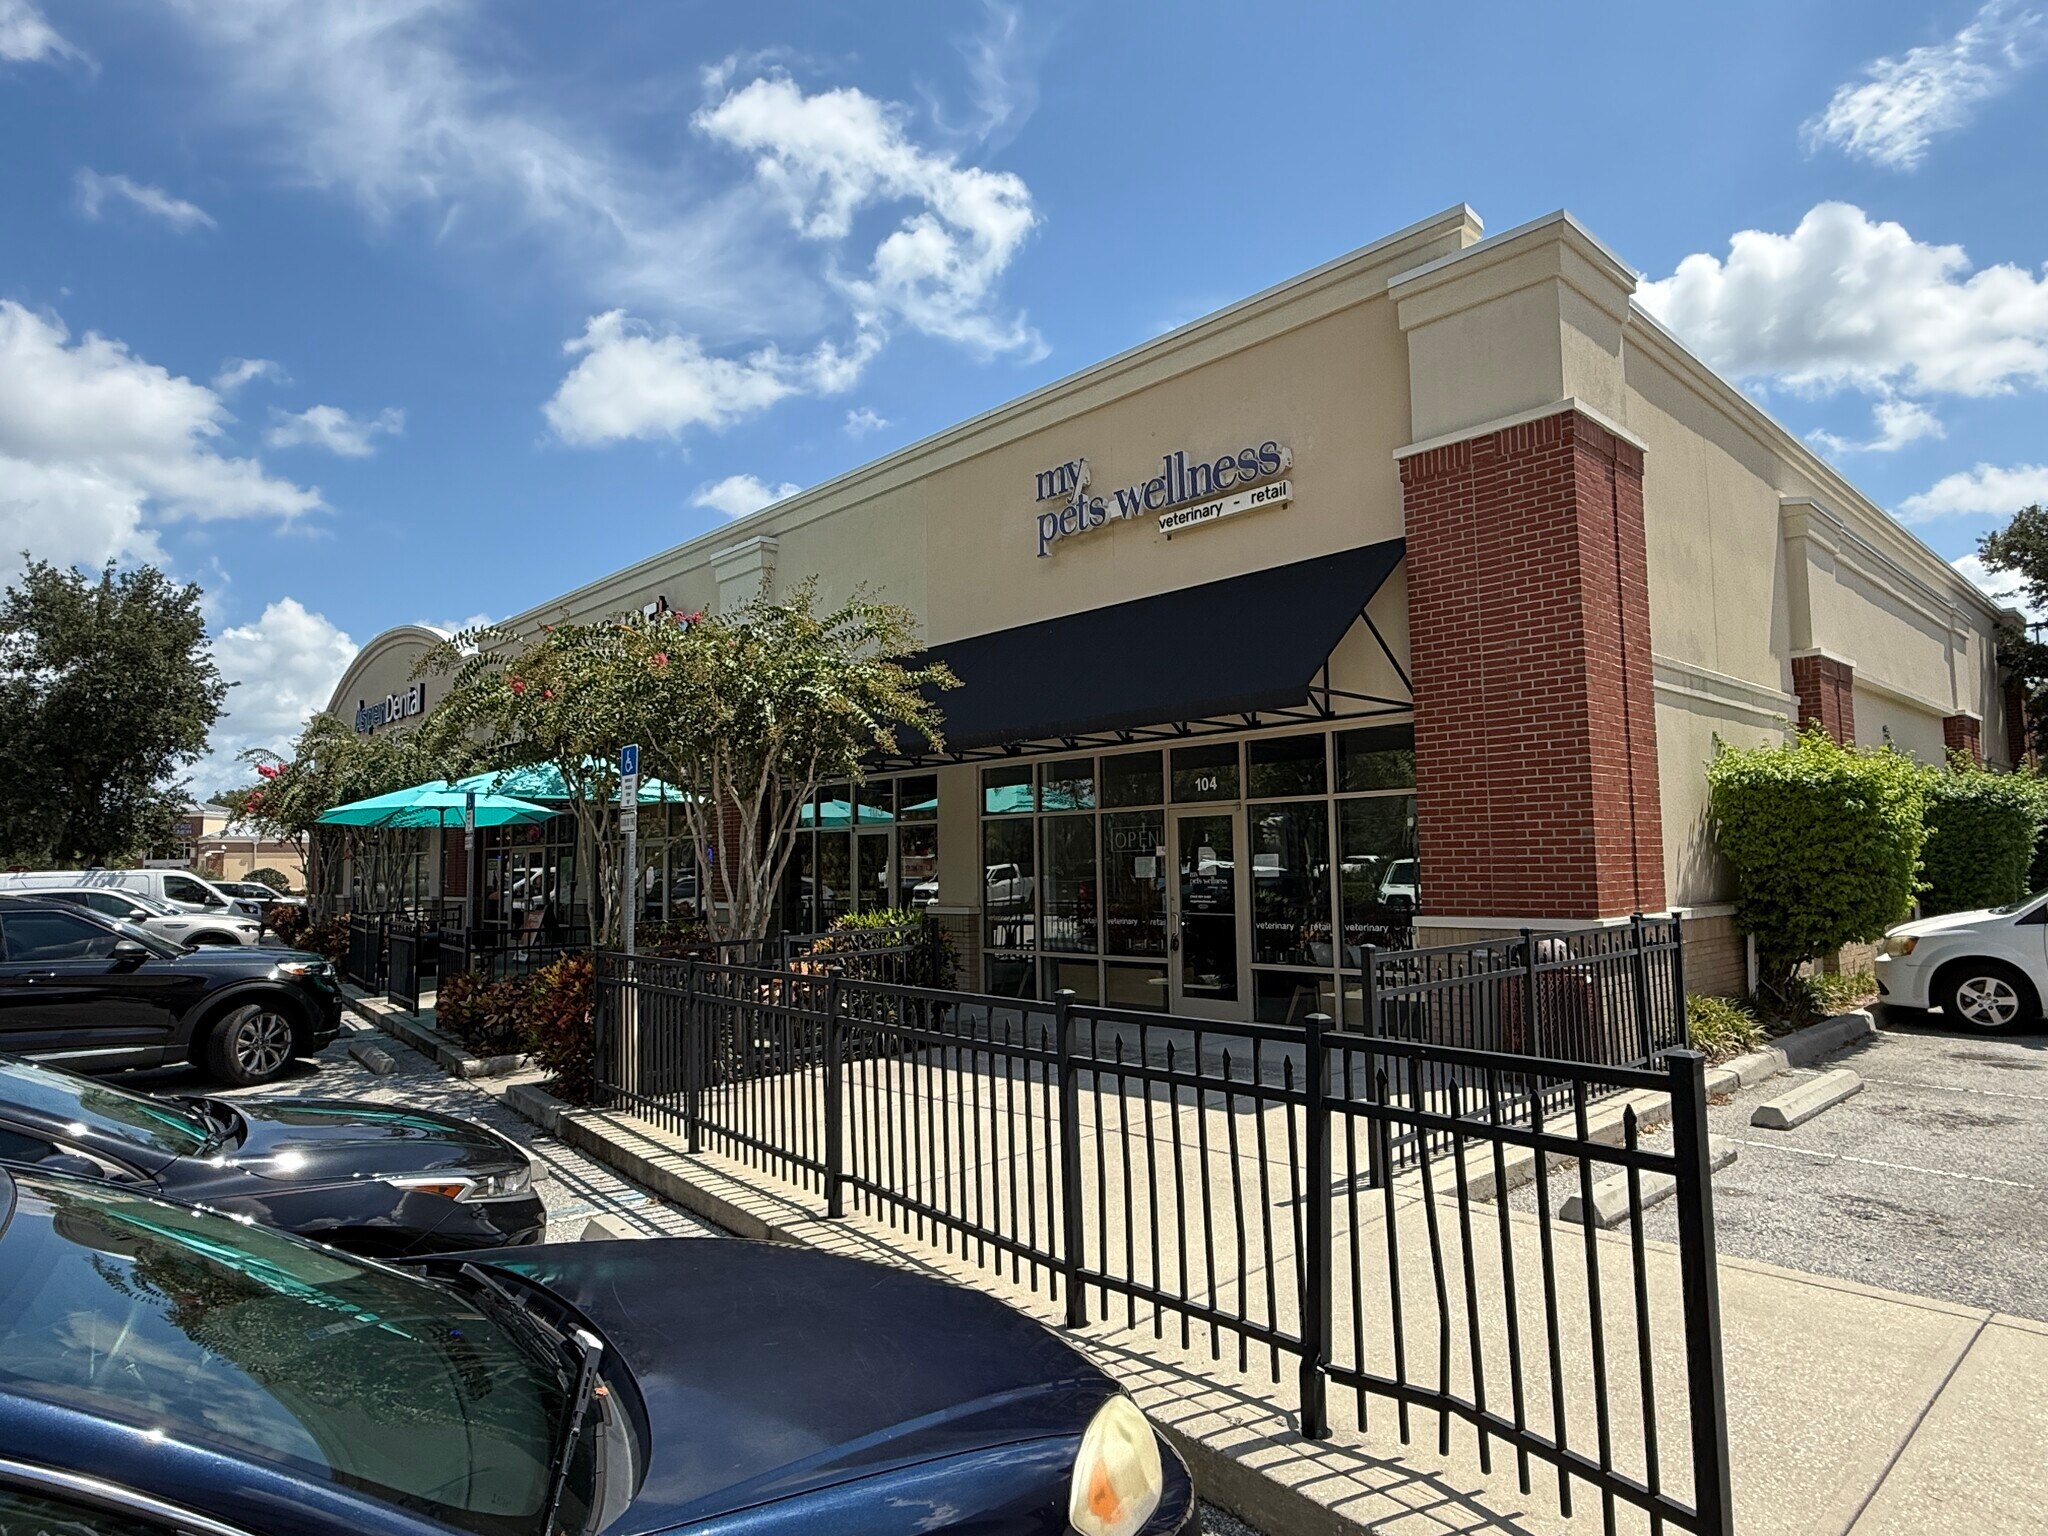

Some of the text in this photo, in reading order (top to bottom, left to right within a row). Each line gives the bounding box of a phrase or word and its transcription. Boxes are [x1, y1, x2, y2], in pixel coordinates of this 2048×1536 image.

[1035, 457, 1089, 502] my
[1036, 440, 1284, 558] pets wellness
[1159, 501, 1223, 530] veterinary
[1250, 482, 1287, 505] retail
[1195, 776, 1218, 791] 104
[1115, 830, 1159, 849] OPEN
[1107, 917, 1138, 927] veterinary
[1255, 922, 1331, 931] veterinary retail
[1344, 924, 1389, 933] veterinary
